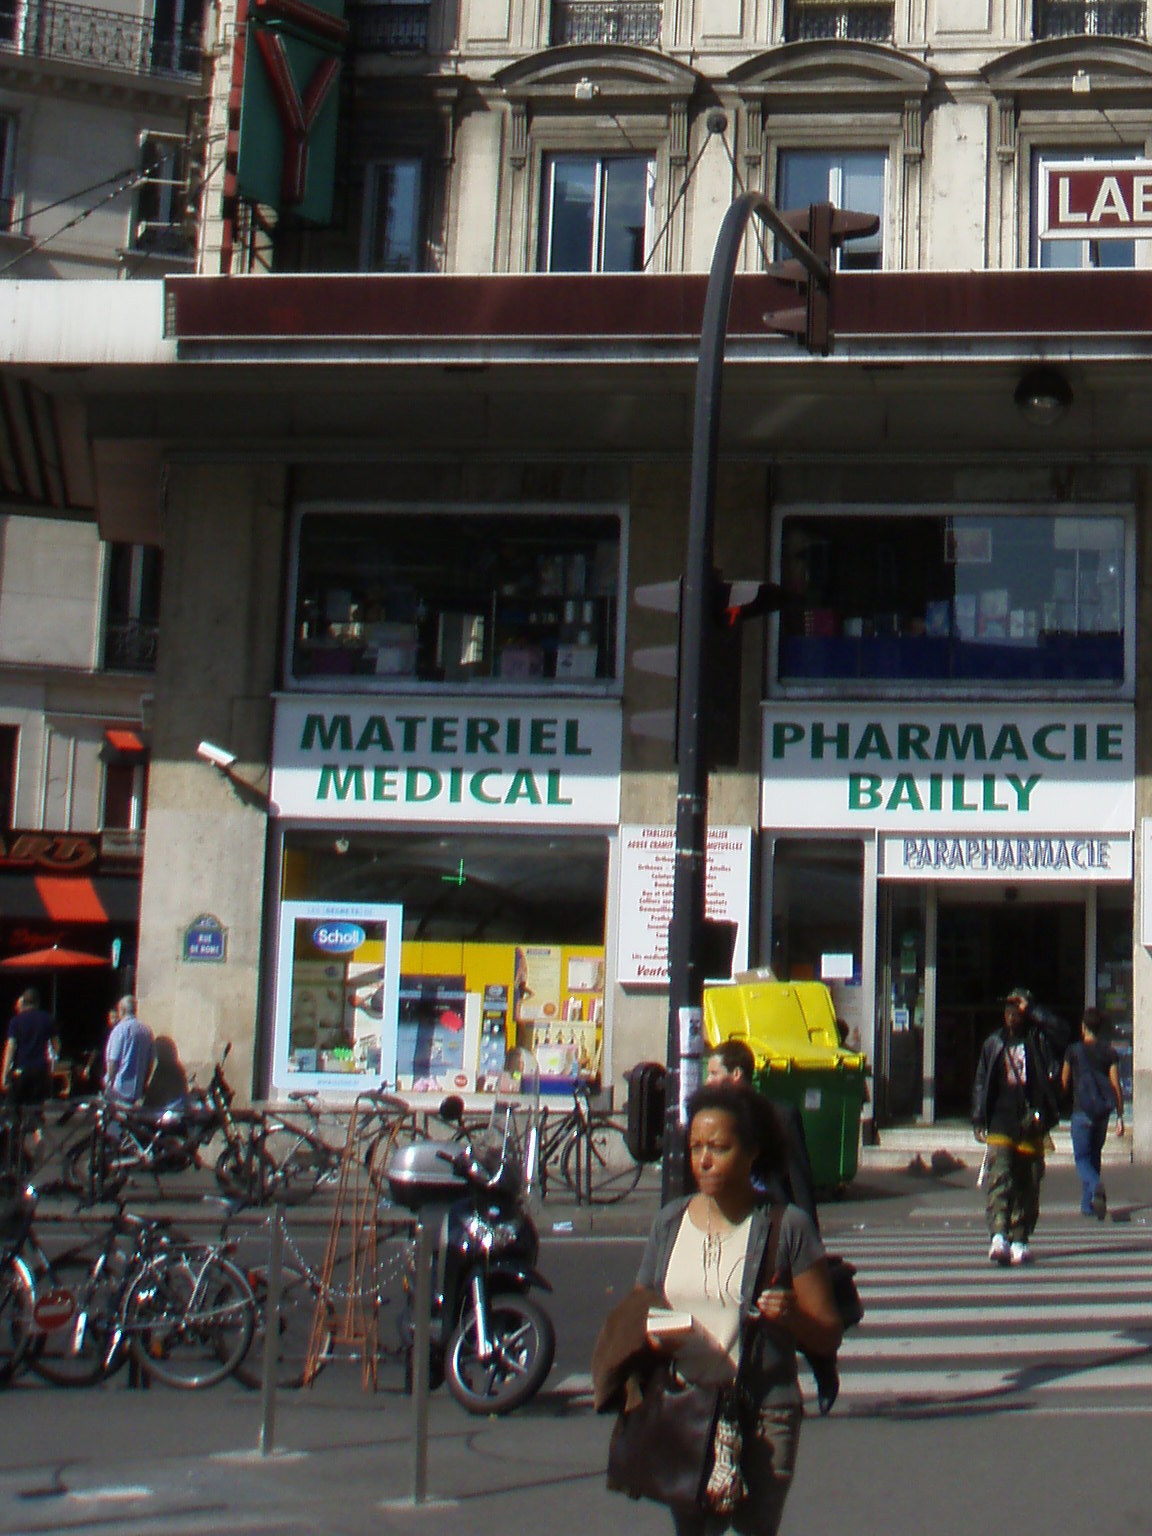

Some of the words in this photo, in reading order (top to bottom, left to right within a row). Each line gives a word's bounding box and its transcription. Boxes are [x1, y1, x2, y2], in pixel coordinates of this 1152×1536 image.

[299, 714, 592, 756] MATERIEL
[771, 721, 1124, 762] PHARMACIE
[316, 763, 573, 806] MEDICAL
[847, 772, 1042, 812] BAILLY
[902, 837, 1111, 869] PARAPHARMACIE
[318, 929, 360, 944] Scholl
[638, 965, 667, 976] Vente
